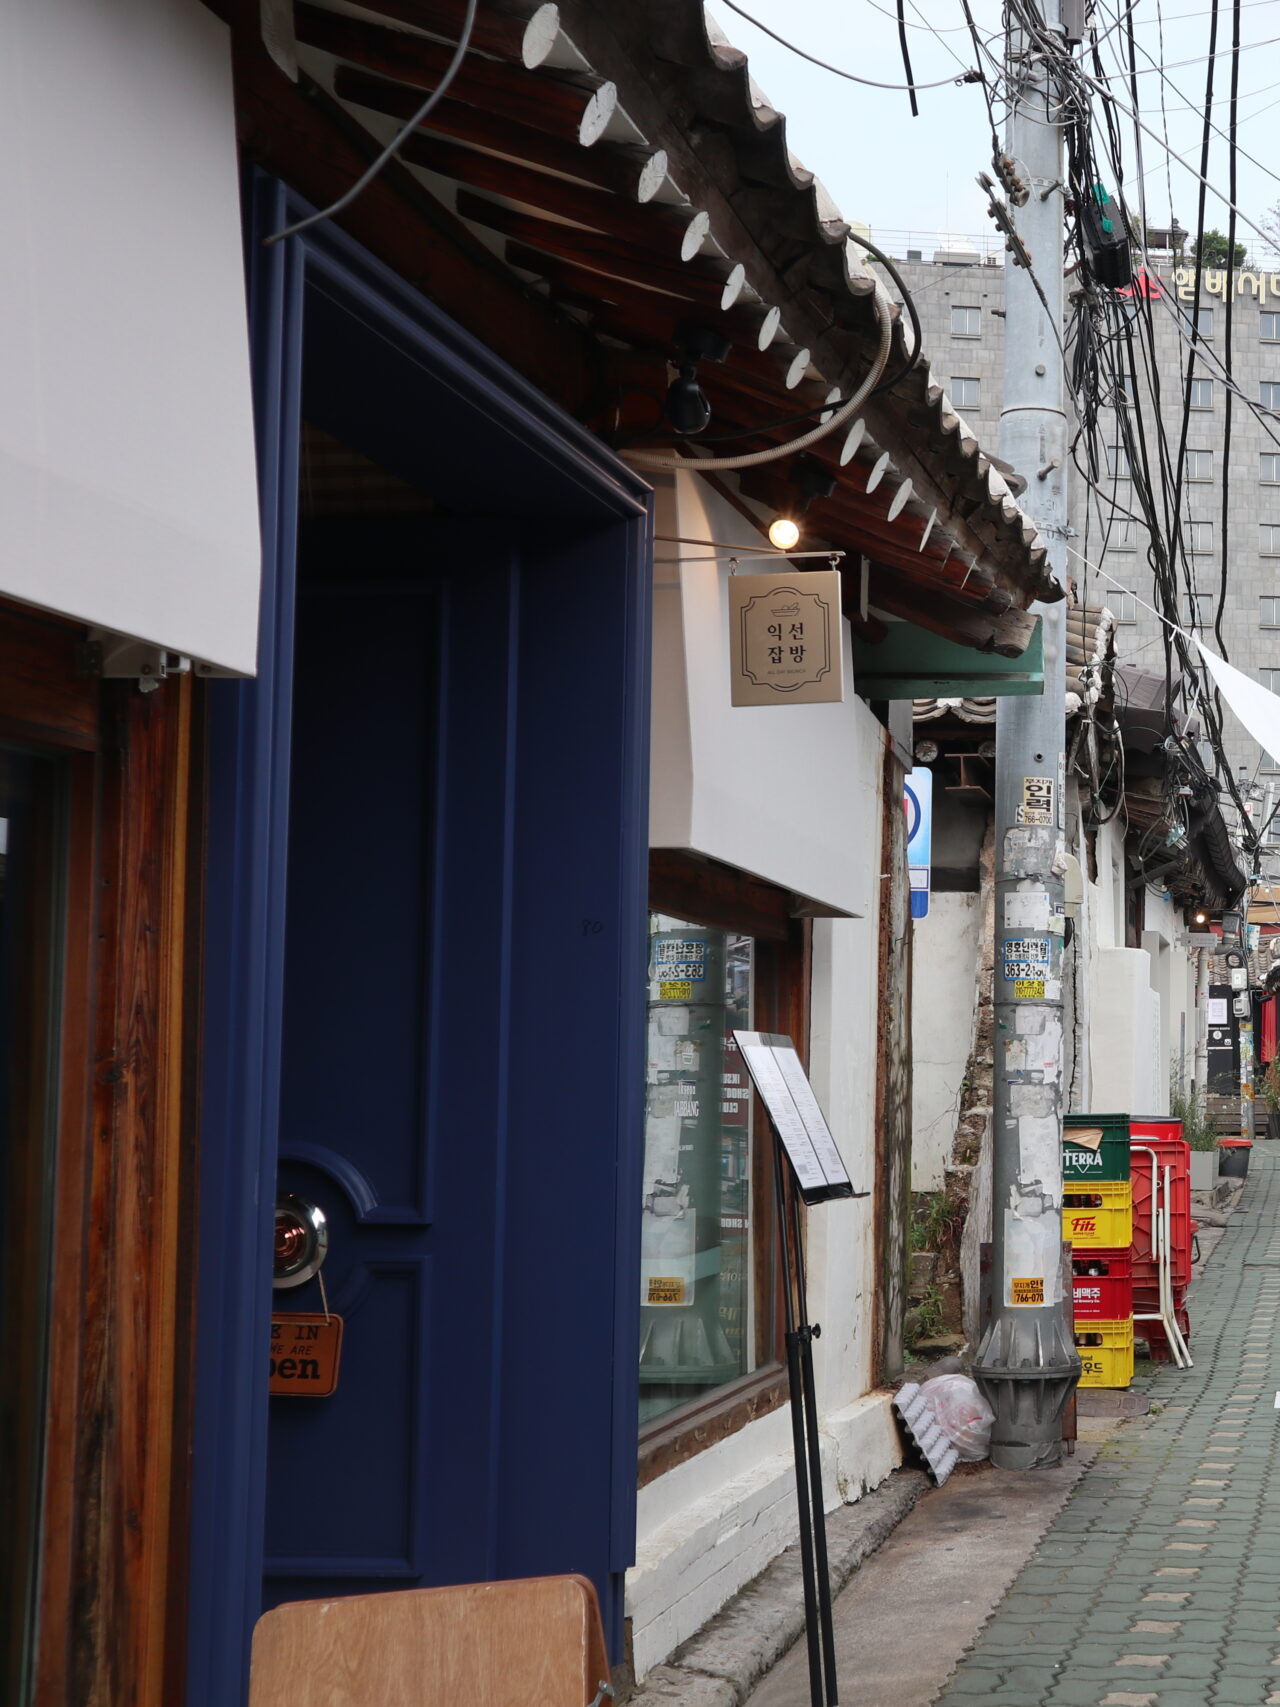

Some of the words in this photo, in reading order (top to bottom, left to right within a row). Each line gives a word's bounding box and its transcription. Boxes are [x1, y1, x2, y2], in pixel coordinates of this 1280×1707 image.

[768, 623, 804, 641] 익선
[768, 646, 806, 664] 잡방
[1025, 785, 1052, 812] 인력
[1024, 815, 1053, 824] 766-0700
[1063, 1149, 1103, 1166] TERRA
[1071, 1216, 1096, 1231] Fitz
[1015, 1293, 1044, 1303] 766-070
[1073, 1287, 1101, 1298] 비맥주
[295, 1325, 319, 1340] IN
[290, 1345, 313, 1355] ARE
[270, 1358, 321, 1380] en
[1082, 1362, 1104, 1375] 우드
